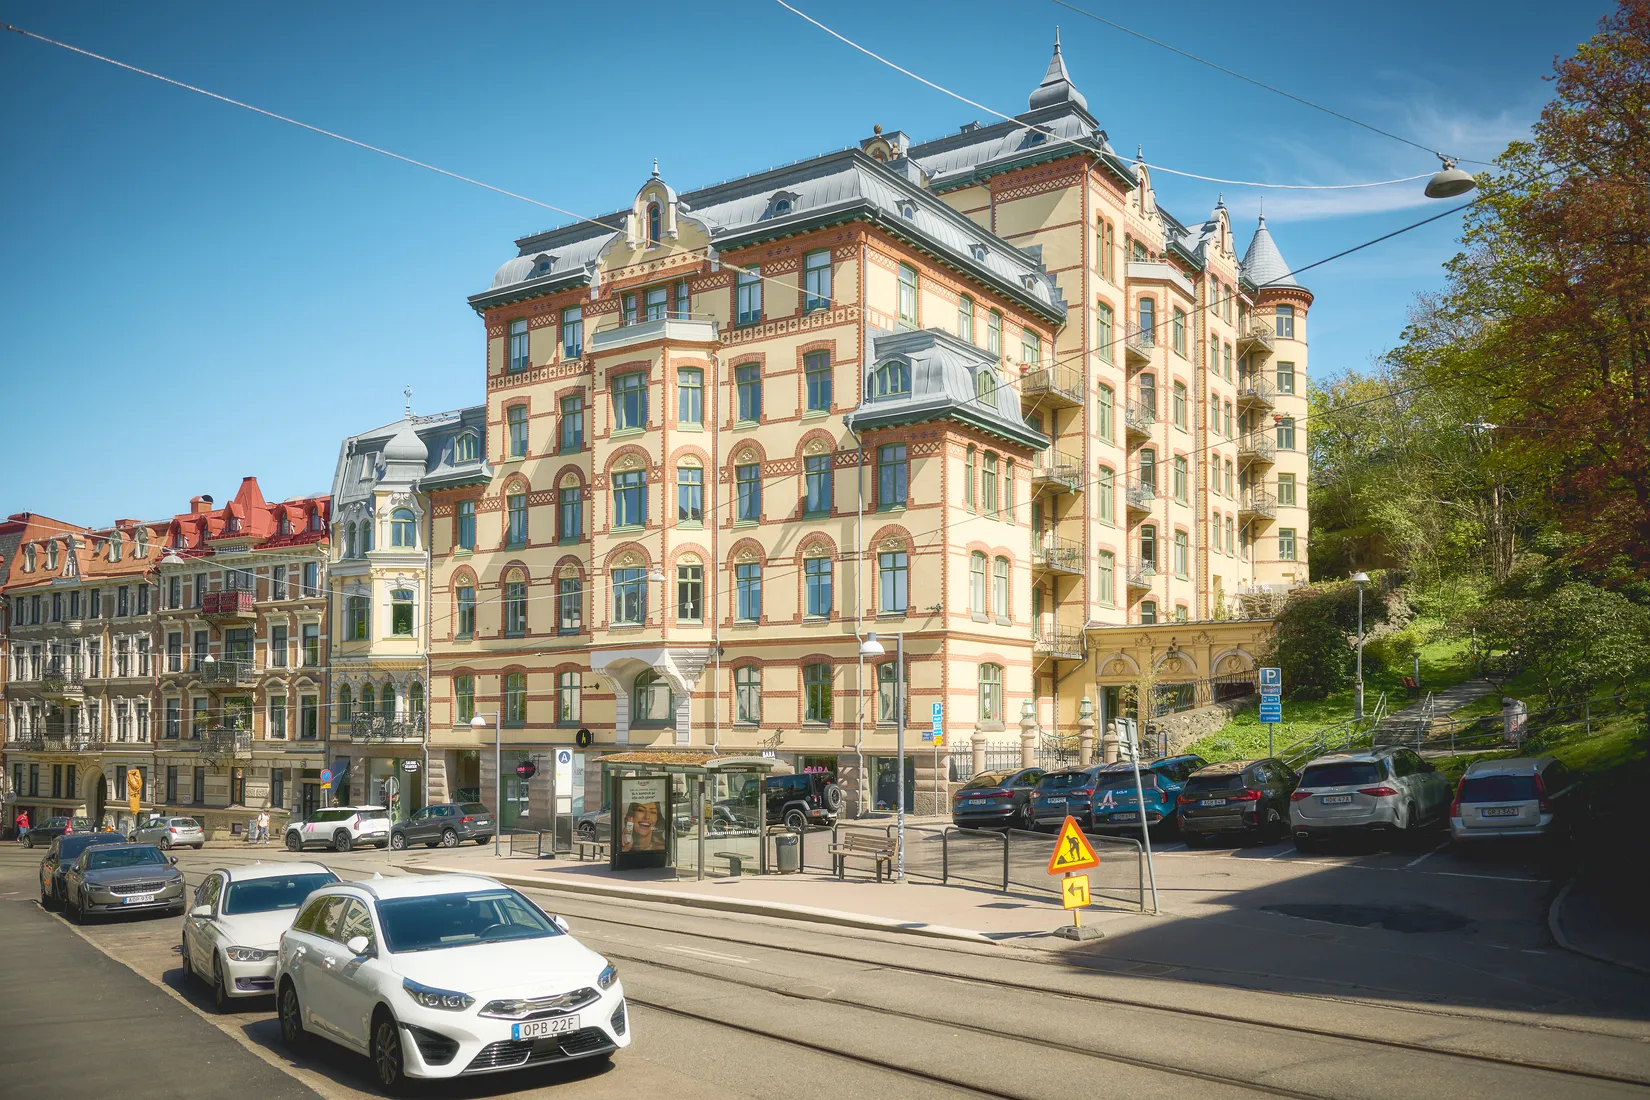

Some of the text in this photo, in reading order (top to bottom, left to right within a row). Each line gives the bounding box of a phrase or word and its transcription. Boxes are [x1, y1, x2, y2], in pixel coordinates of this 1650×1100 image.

[1266, 669, 1277, 684] P
[934, 703, 940, 715] P
[561, 753, 568, 762] A
[807, 765, 829, 773] BARA
[523, 1018, 574, 1036] OPB 22F
